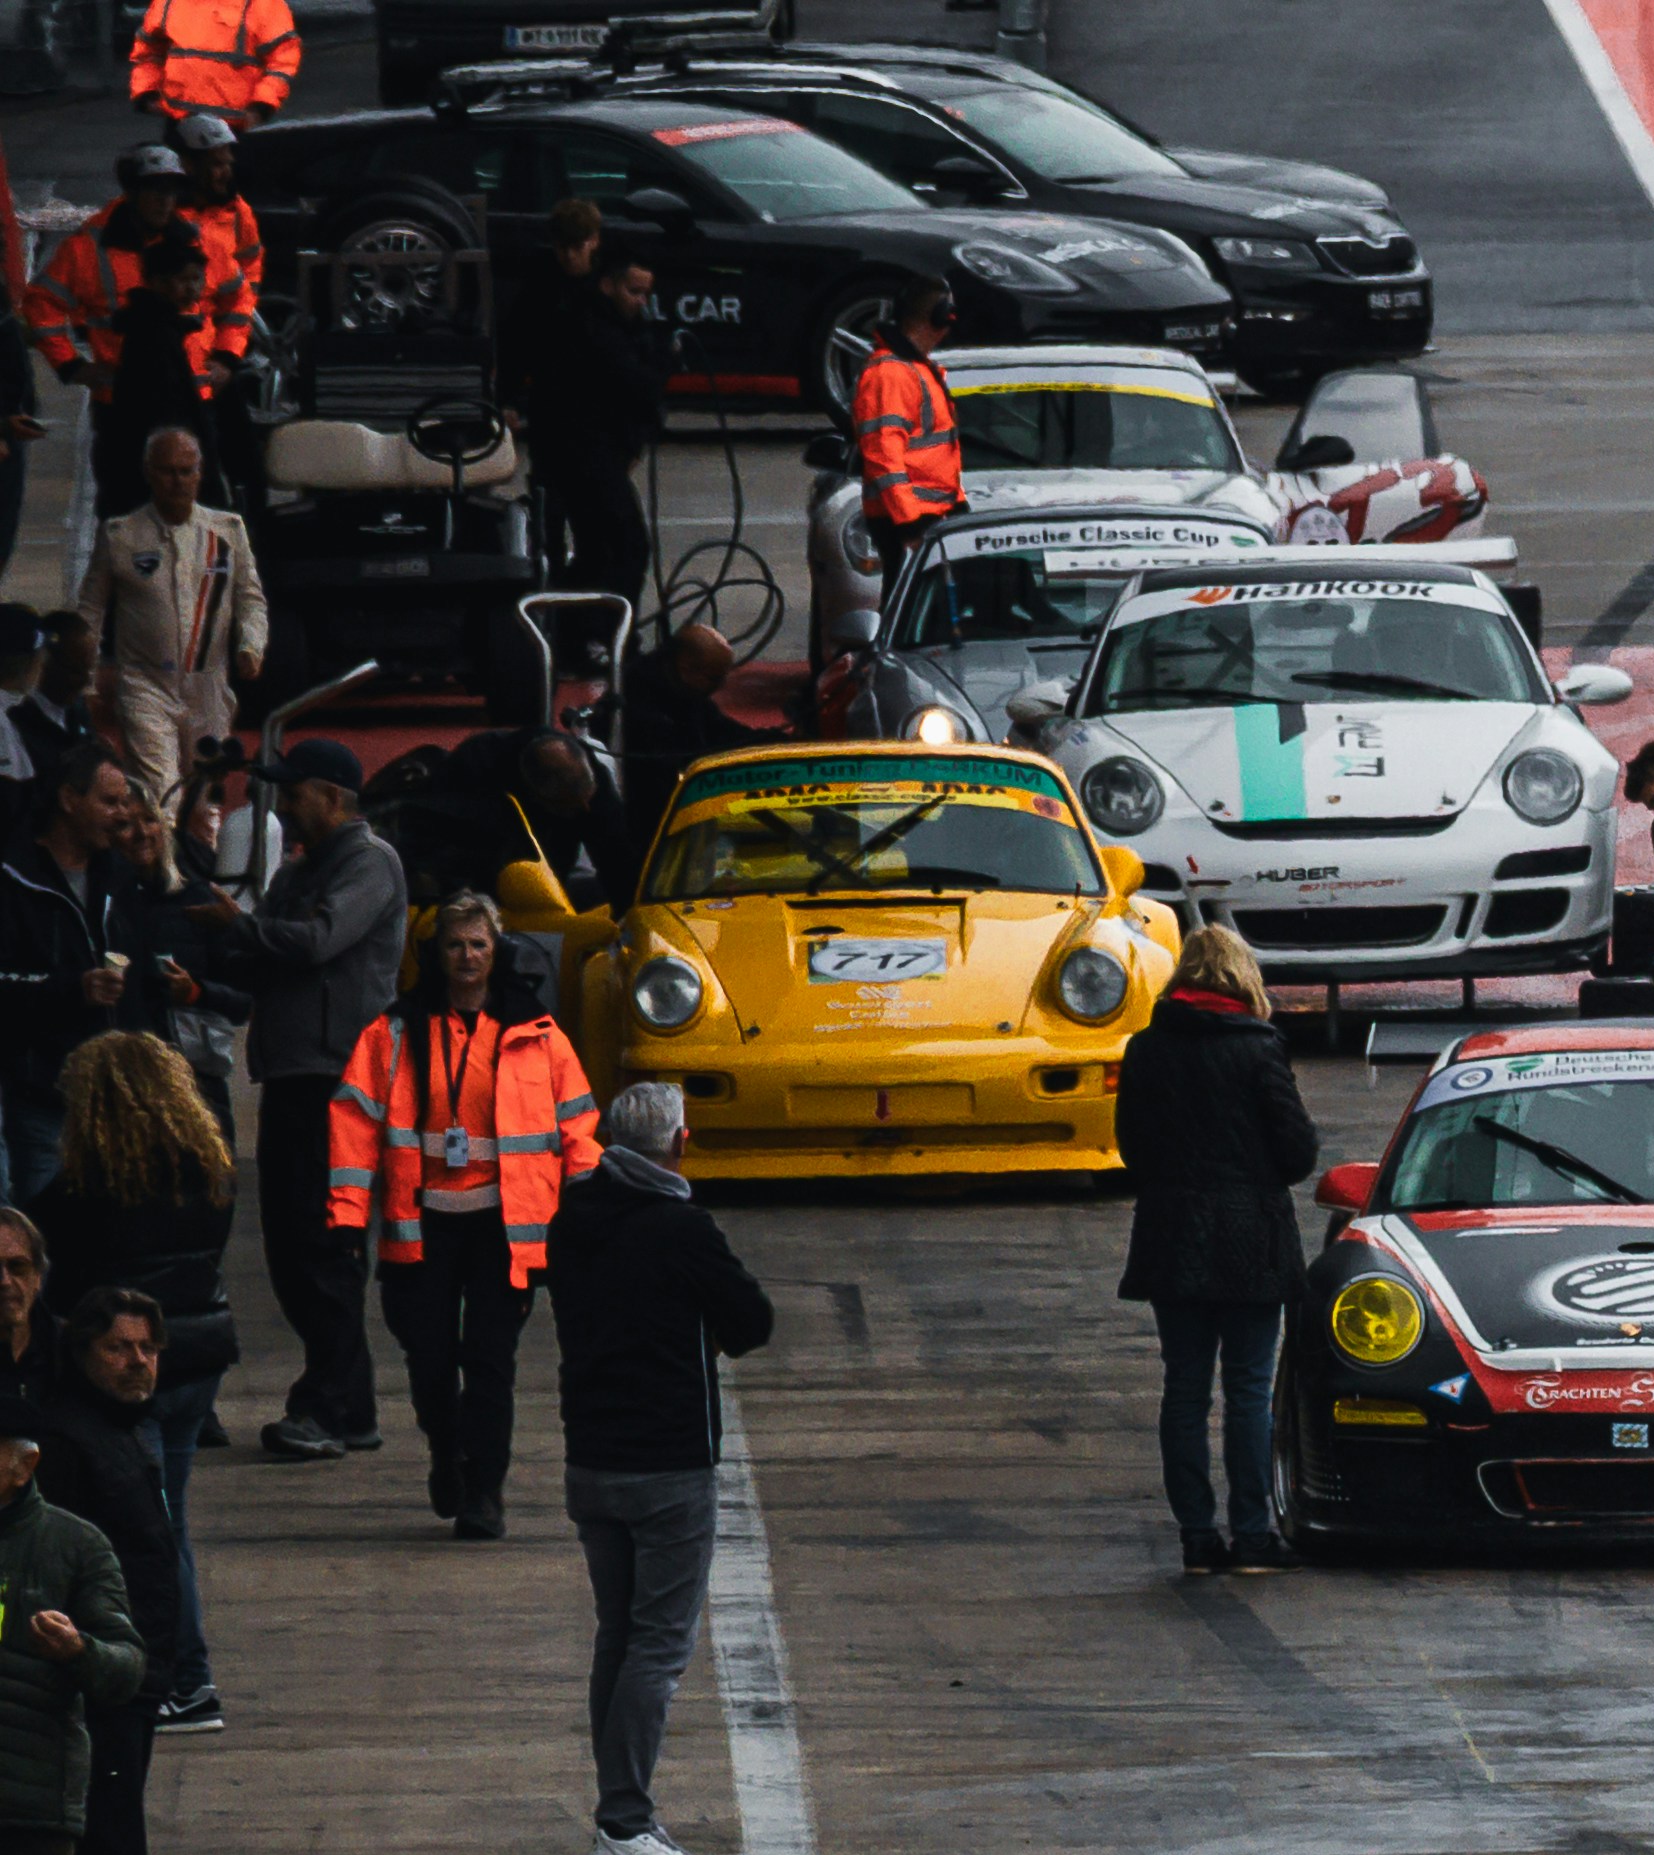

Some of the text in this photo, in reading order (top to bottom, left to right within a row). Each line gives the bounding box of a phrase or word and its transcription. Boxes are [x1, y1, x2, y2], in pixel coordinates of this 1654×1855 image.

[678, 295, 741, 322] CAR
[975, 526, 1219, 550] Porsche Classic Cup
[1256, 866, 1340, 882] HUBER
[832, 952, 929, 971] 717
